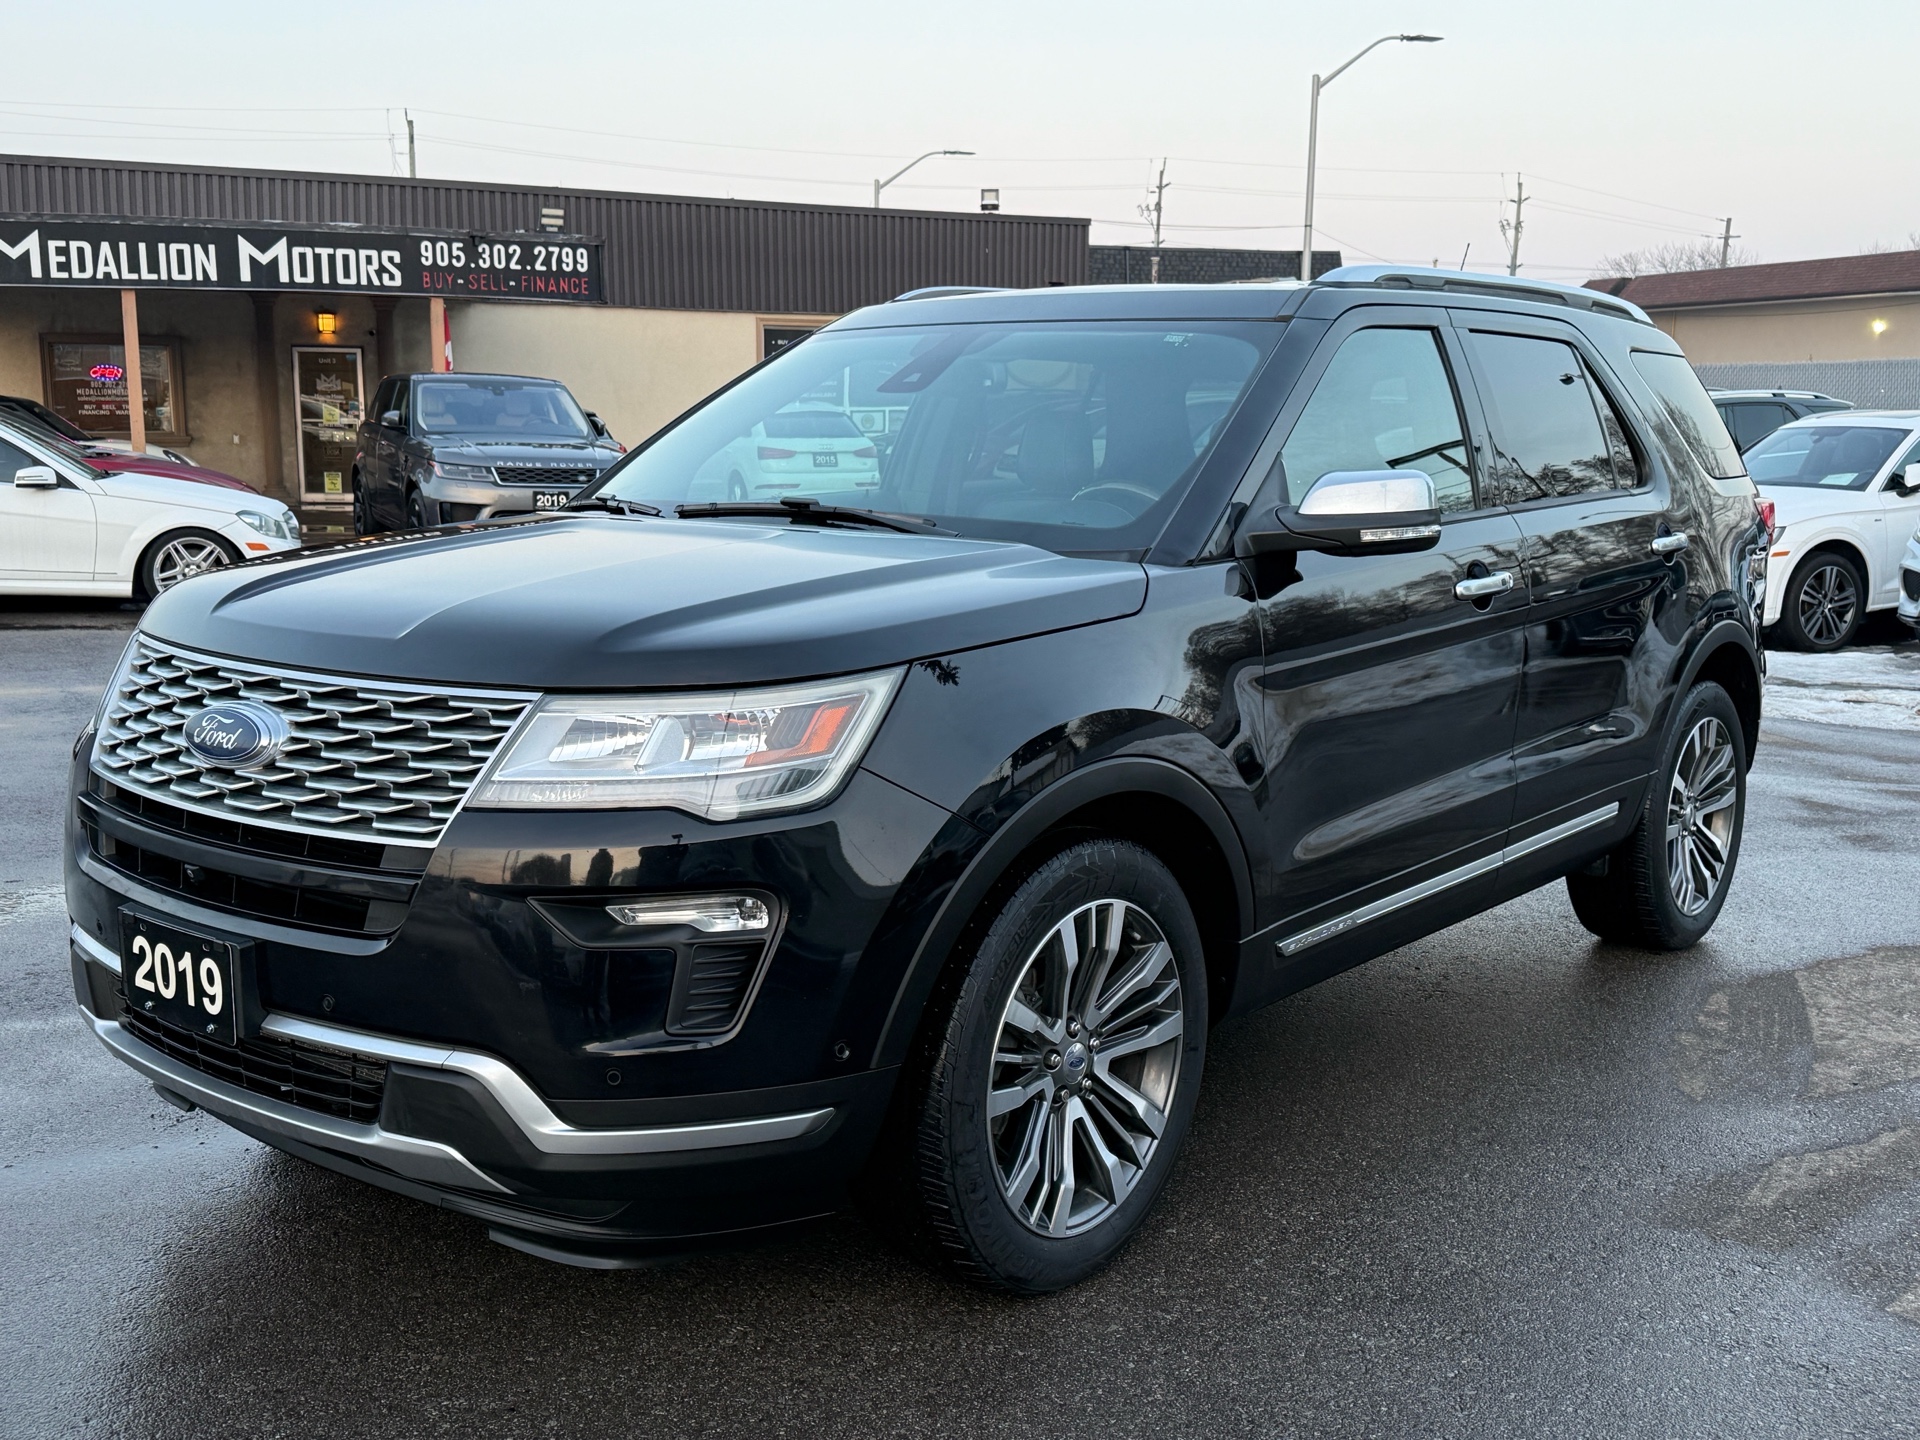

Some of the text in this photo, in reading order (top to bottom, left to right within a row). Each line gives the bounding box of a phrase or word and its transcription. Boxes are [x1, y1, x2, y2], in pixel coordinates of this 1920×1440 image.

[0, 229, 402, 287] MEDALLION MOTORS
[420, 240, 588, 273] 905.302.2799
[89, 366, 123, 379] OPEN
[815, 455, 836, 464] 2015
[536, 494, 567, 507] 2019
[194, 713, 243, 750] Ford
[1287, 919, 1353, 952] EXPLORER
[132, 935, 223, 1016] 2019
